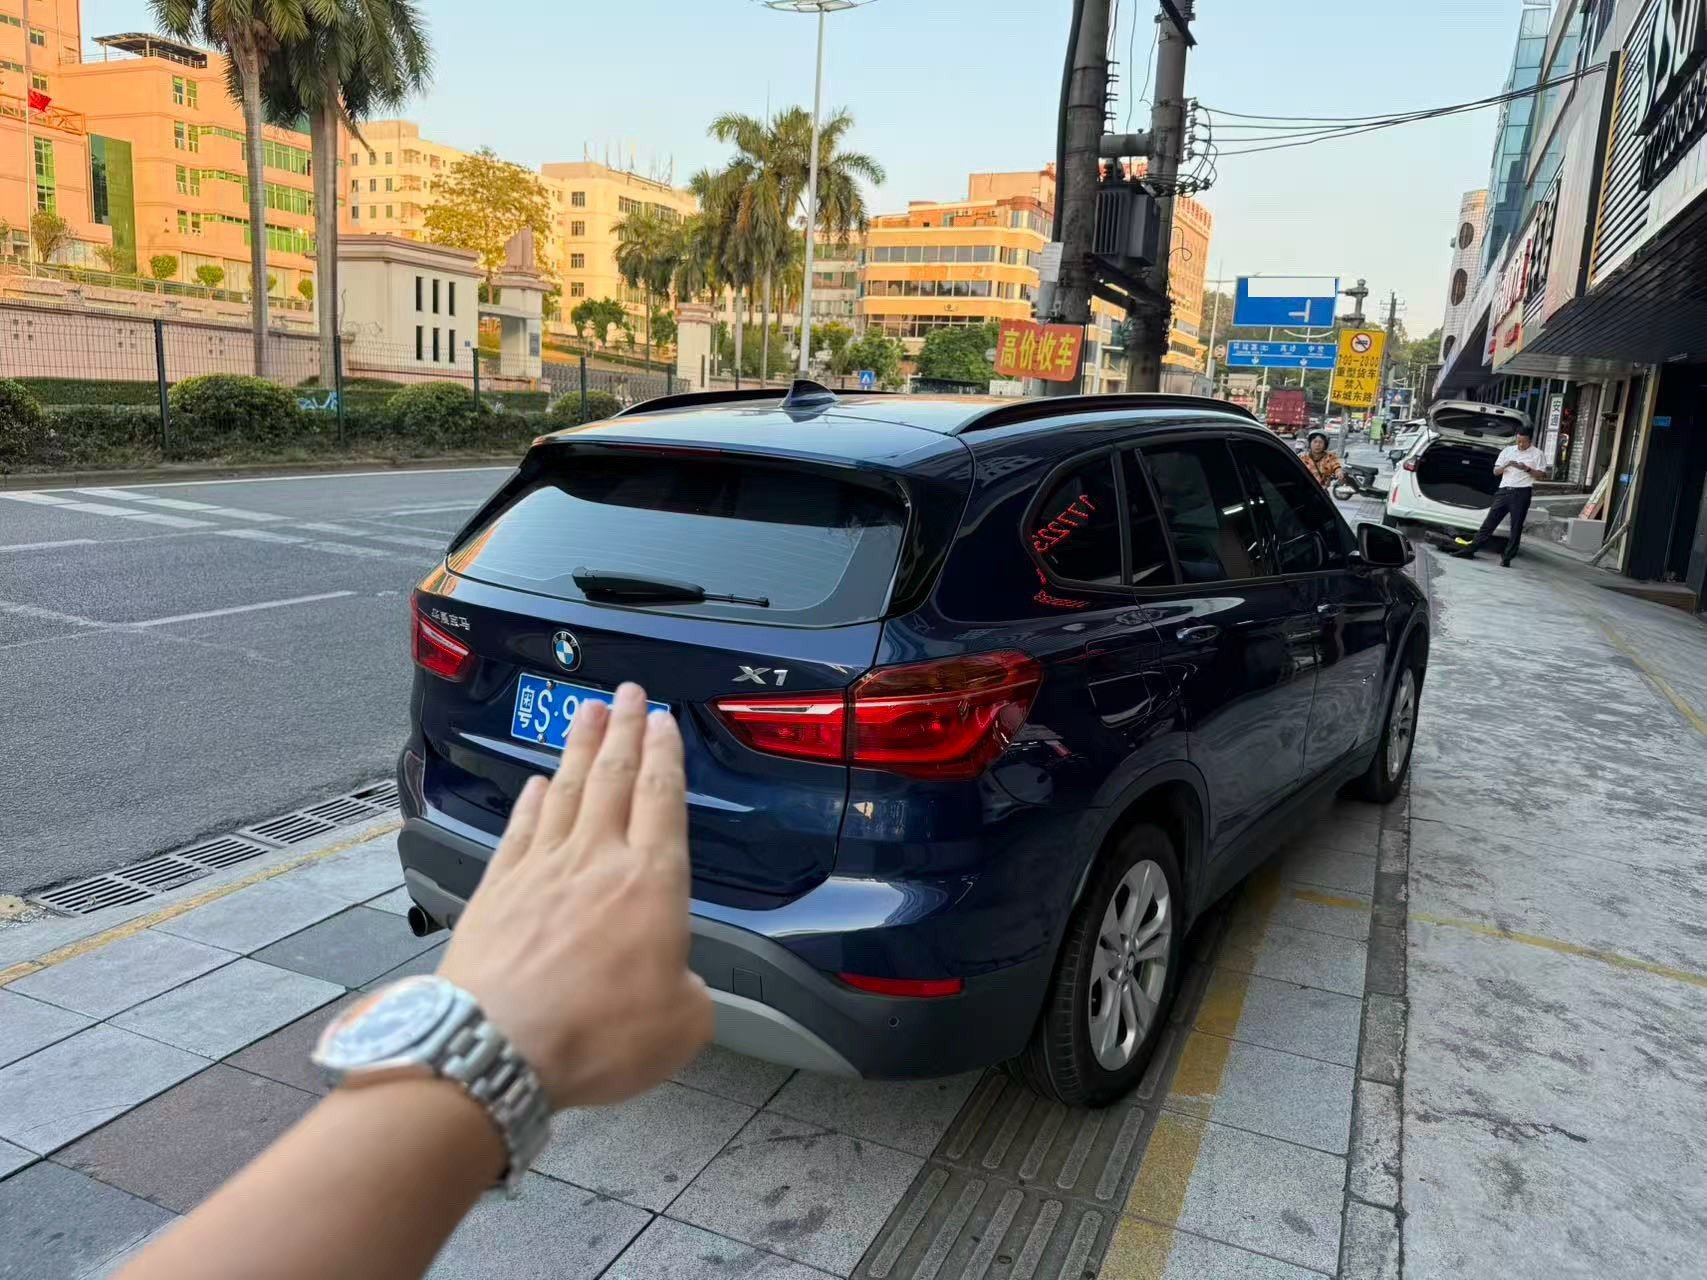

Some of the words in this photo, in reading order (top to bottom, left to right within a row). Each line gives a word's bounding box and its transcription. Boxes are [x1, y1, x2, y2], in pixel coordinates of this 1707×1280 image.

[1000, 328, 1076, 374] 高价收车
[1337, 366, 1377, 379] 重型货车
[1344, 379, 1364, 390] 禁入
[1332, 390, 1373, 402] 环城东路
[731, 665, 789, 687] X1
